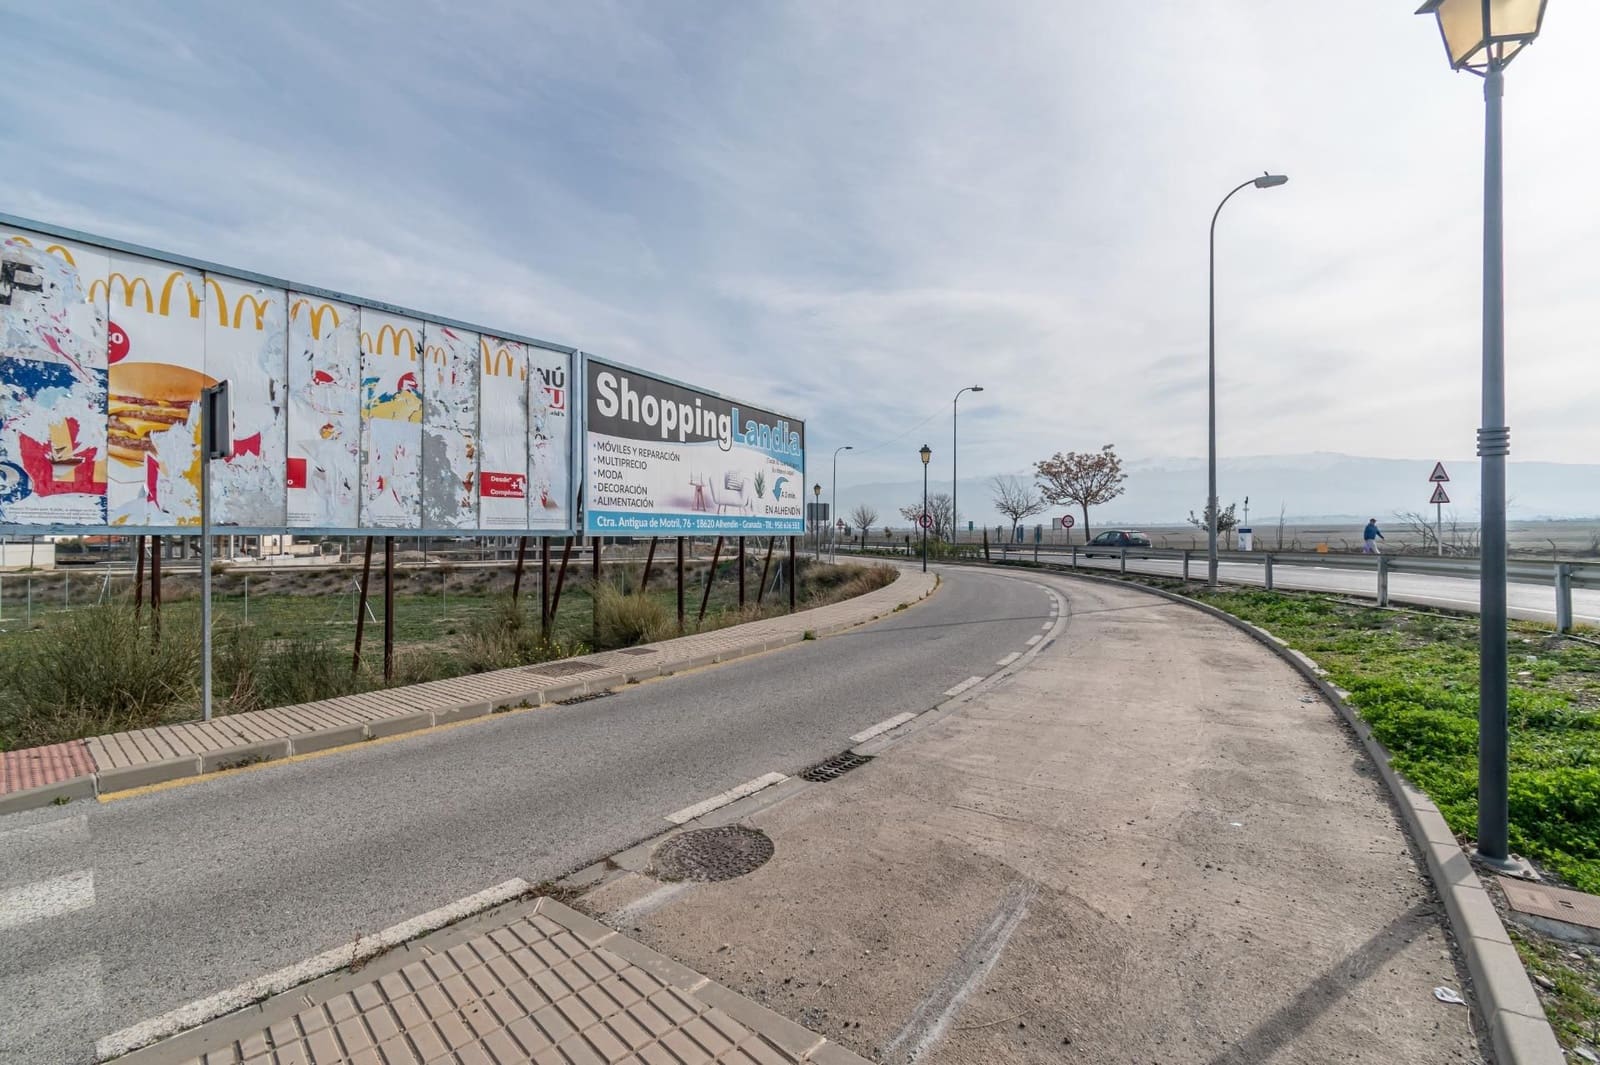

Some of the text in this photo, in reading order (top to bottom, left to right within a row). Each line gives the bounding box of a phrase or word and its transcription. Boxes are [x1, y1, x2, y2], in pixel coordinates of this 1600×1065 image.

[597, 440, 681, 462] MÓVILES Y REPARACIÓN
[597, 455, 648, 470] MULTIPRECIO
[597, 469, 623, 480] MODA
[597, 482, 648, 495] DECORACIÓN
[597, 496, 654, 508] ALIMENTACIÓN
[765, 504, 773, 514] EN
[596, 515, 617, 527] Ctra.
[618, 516, 648, 530] Antigua
[649, 517, 658, 528] de
[683, 518, 691, 528] 76
